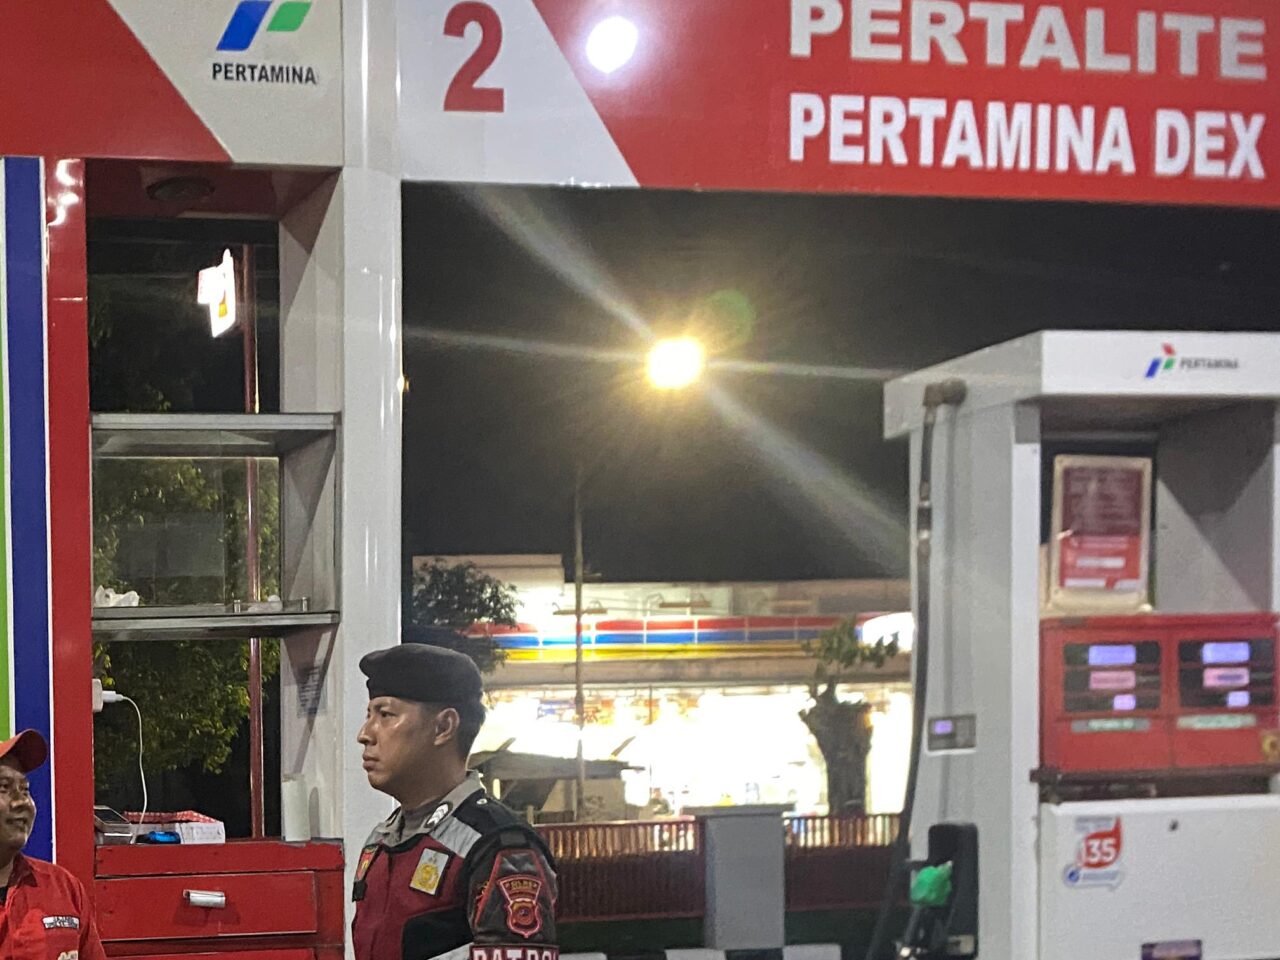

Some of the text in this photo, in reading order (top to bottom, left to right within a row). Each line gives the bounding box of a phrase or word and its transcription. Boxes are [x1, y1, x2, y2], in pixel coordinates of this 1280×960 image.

[212, 62, 317, 85] PERTAMINA
[443, 1, 505, 113] 2
[789, 0, 1268, 80] PERTALITE
[789, 92, 1266, 180] PERTAMINA DEX
